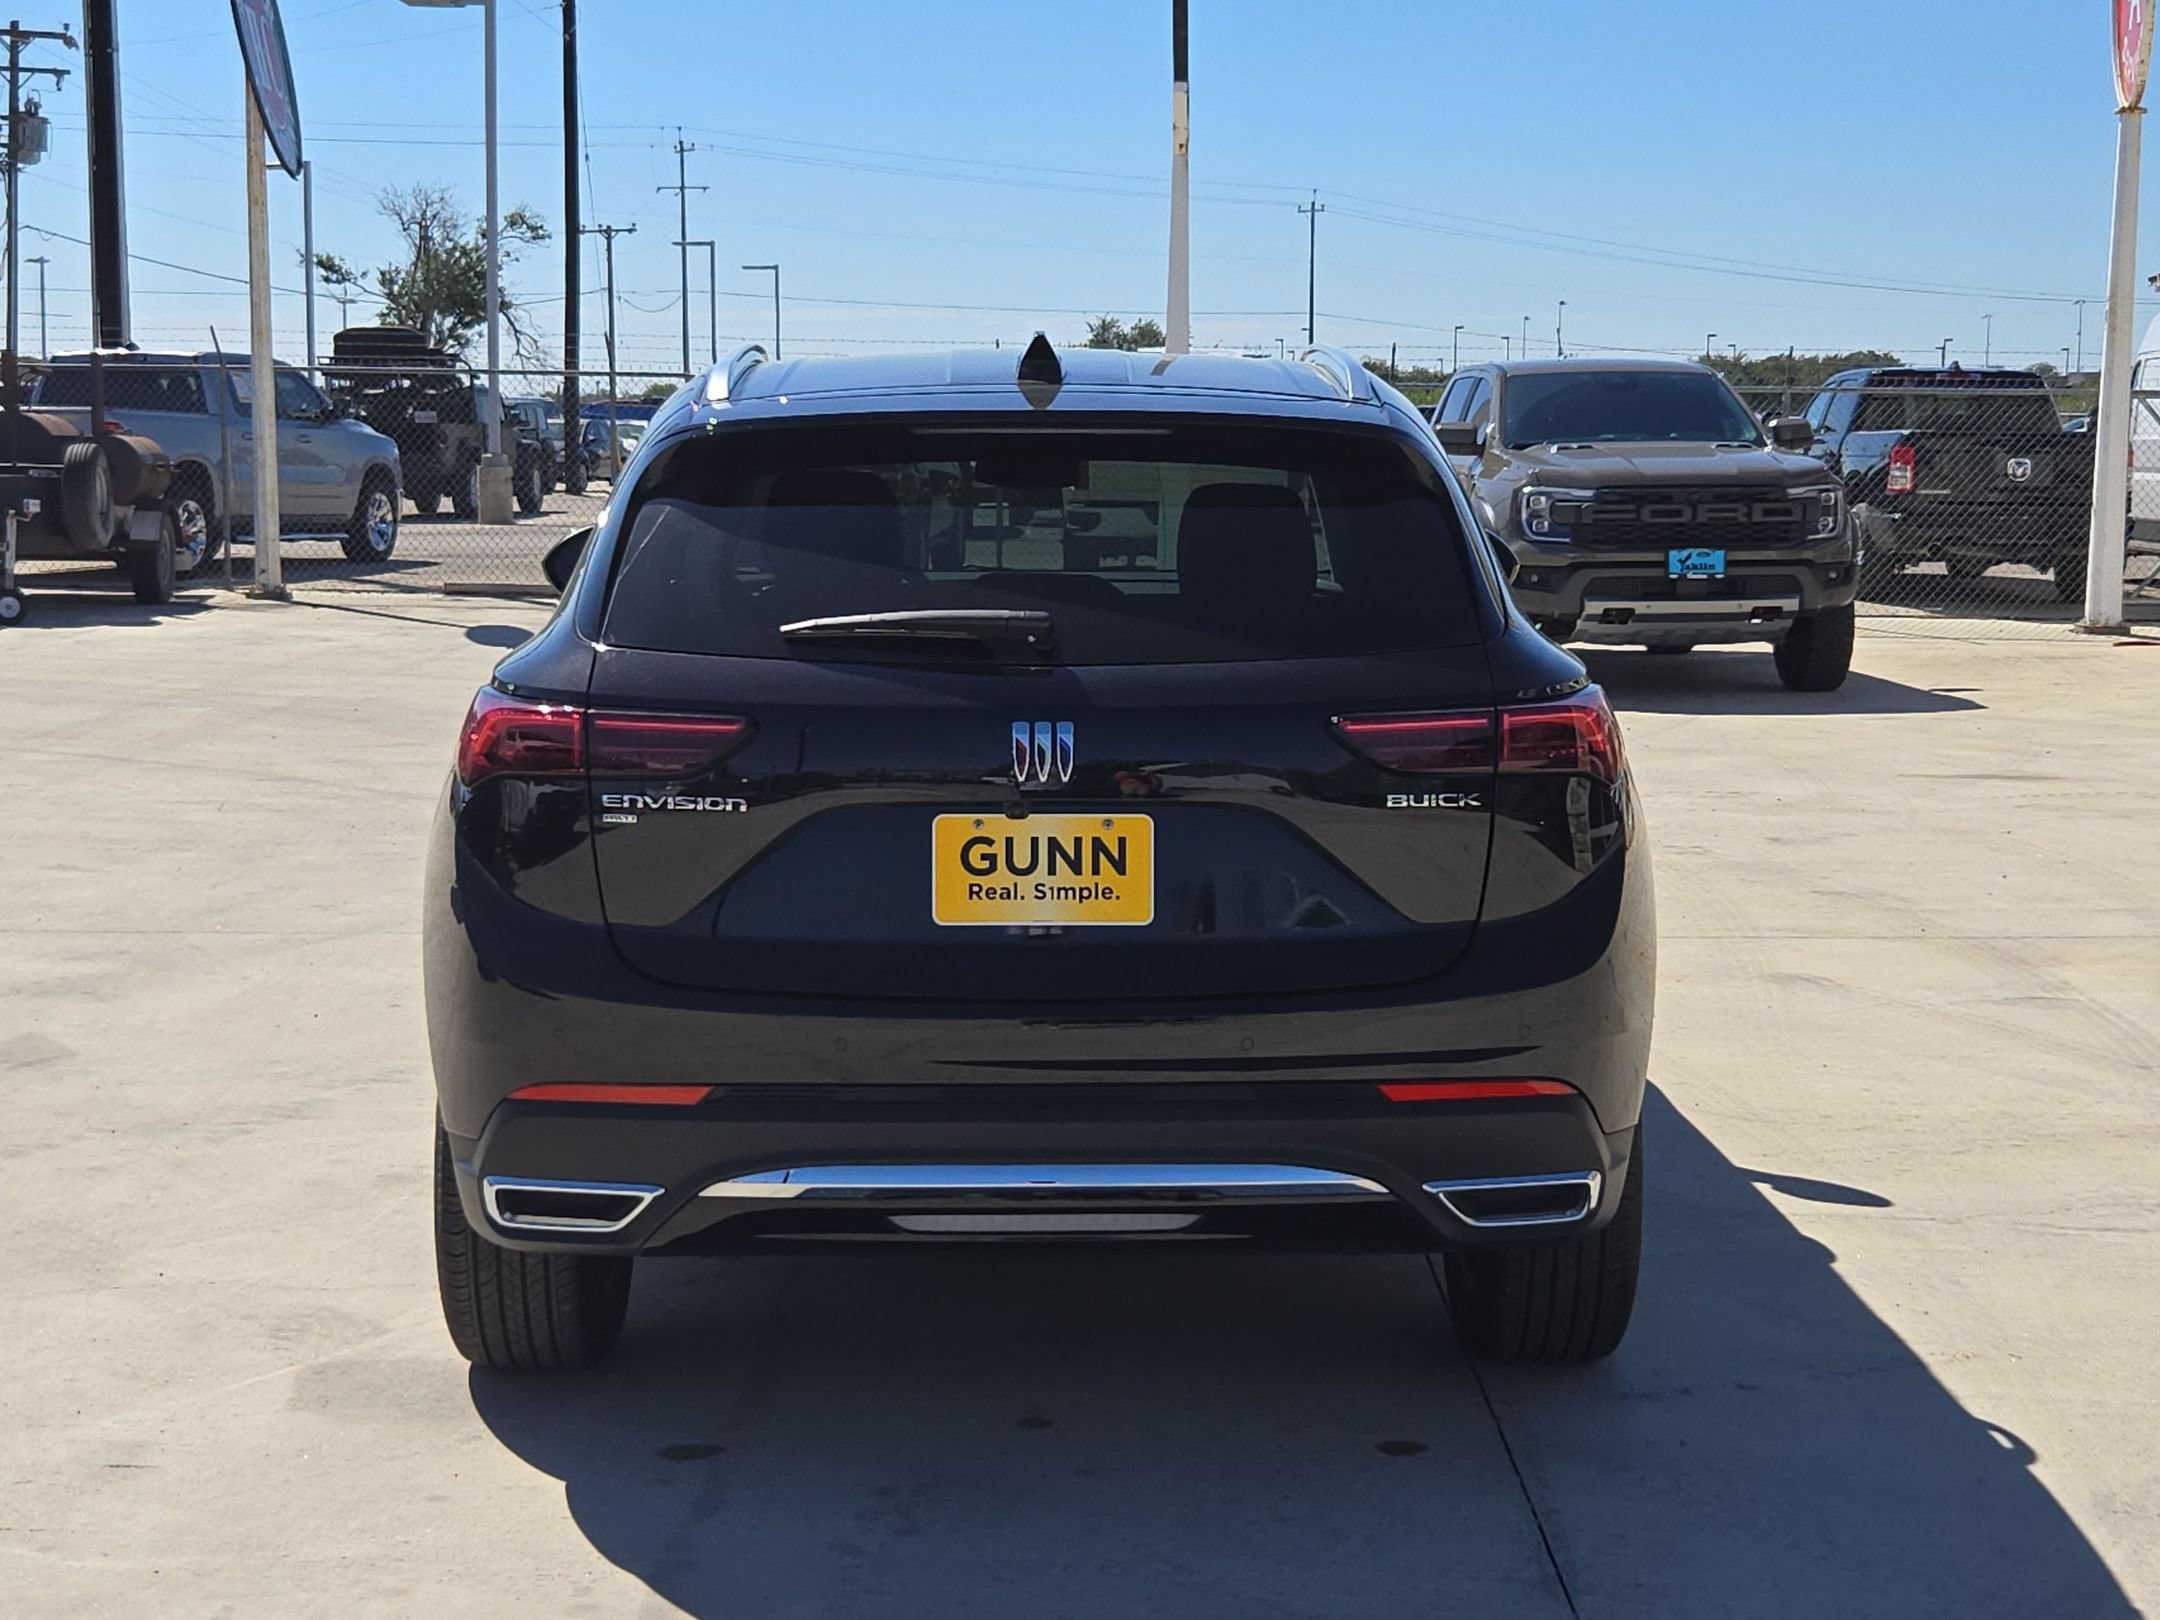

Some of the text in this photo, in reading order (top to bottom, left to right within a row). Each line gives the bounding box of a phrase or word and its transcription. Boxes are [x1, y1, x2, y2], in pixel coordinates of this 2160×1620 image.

[1581, 502, 1804, 523] FORD
[1676, 552, 1716, 573] Yaklin
[1386, 793, 1482, 808] BUICK
[959, 835, 1127, 876] GUNN
[968, 882, 1121, 904] Real. Simple.
